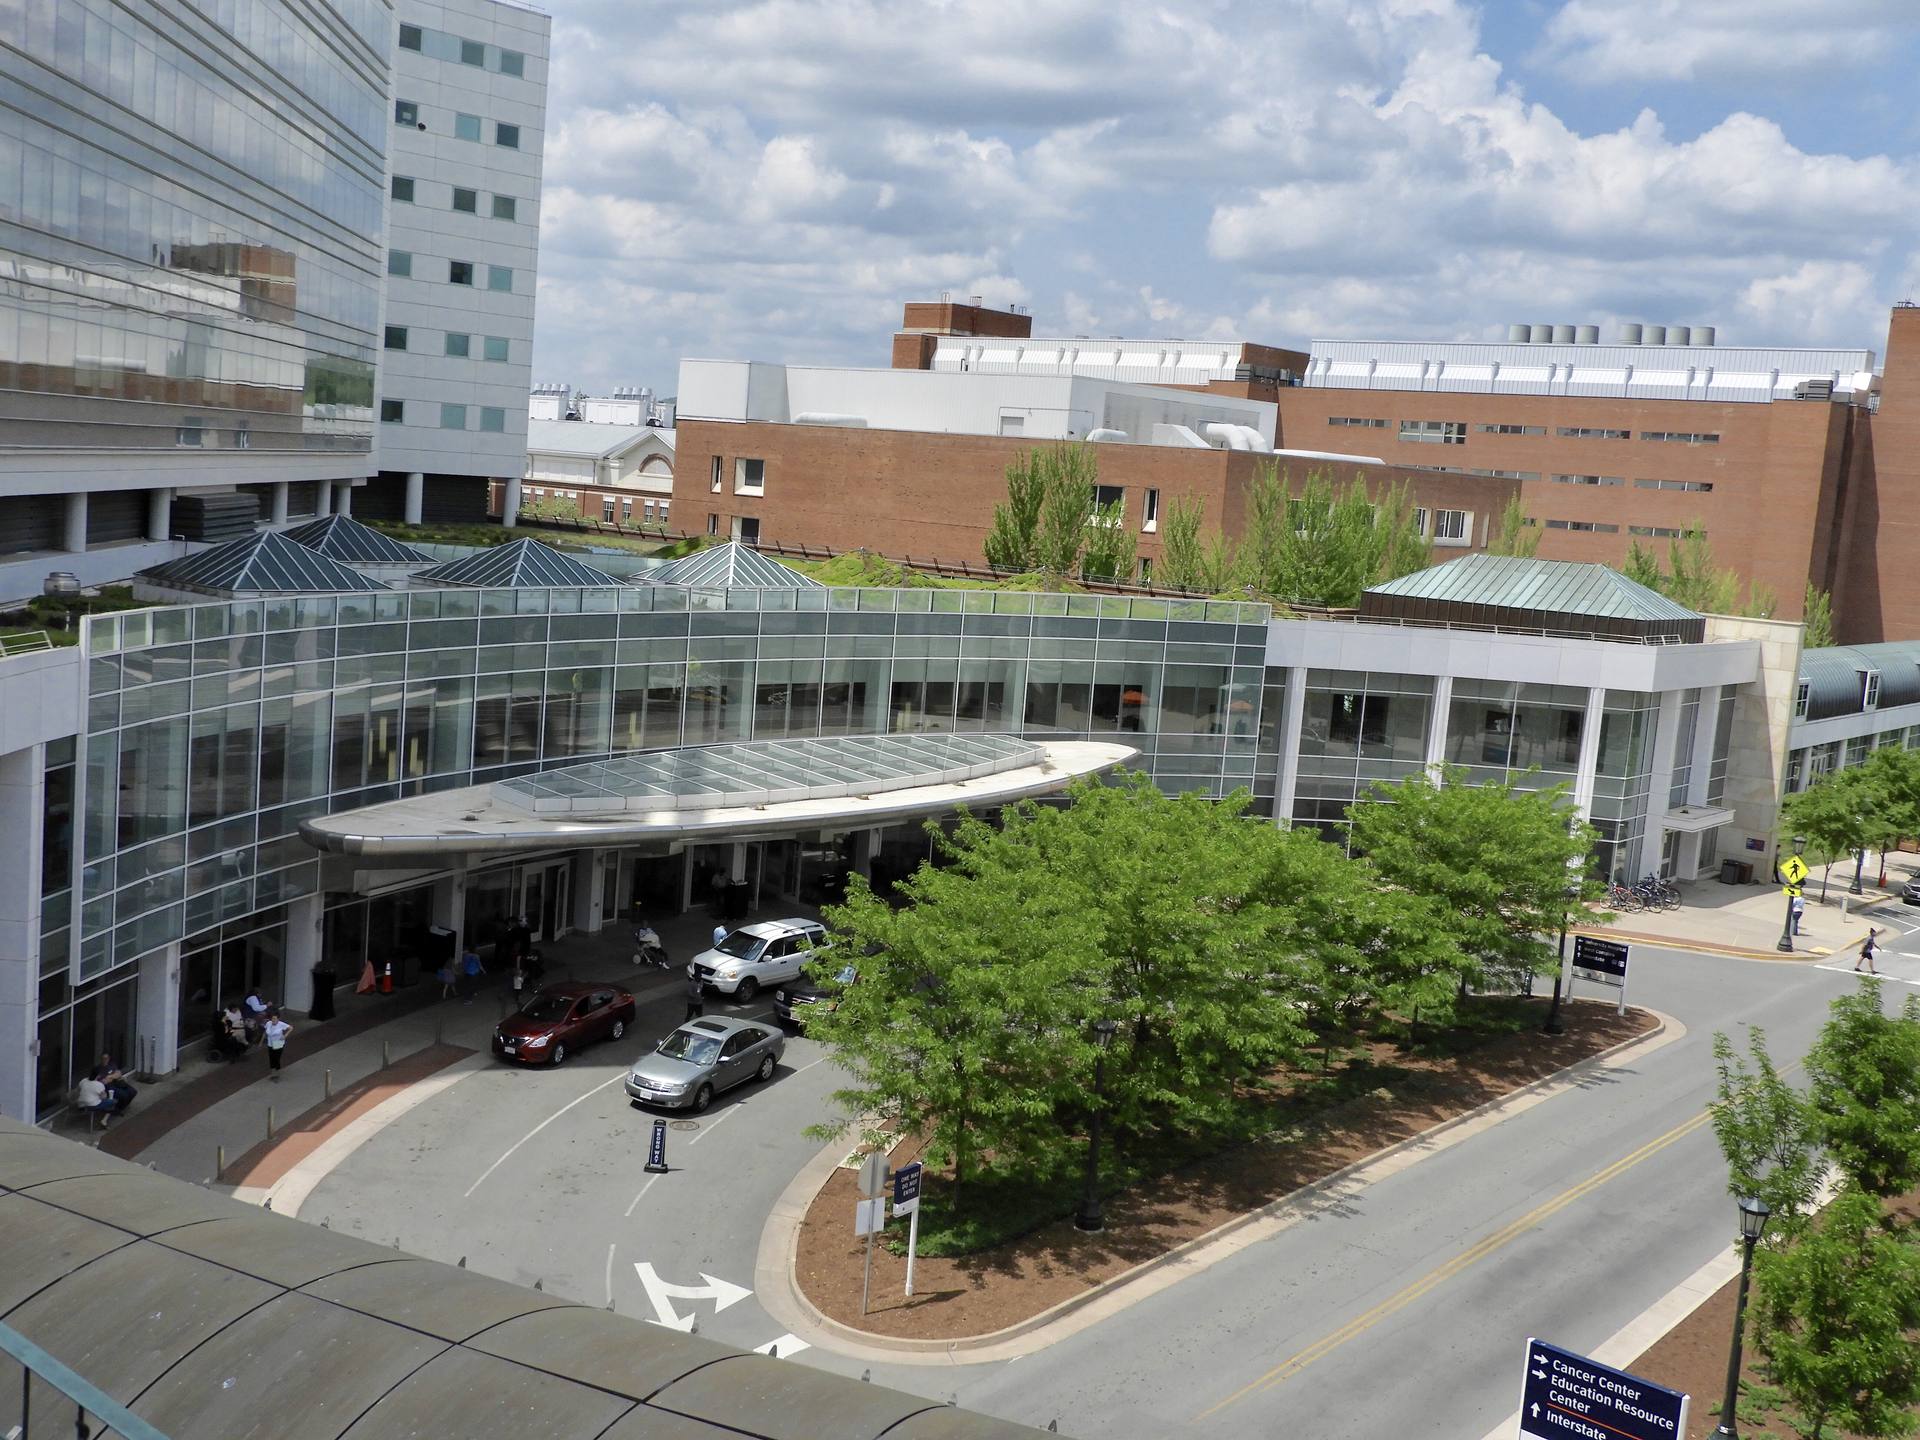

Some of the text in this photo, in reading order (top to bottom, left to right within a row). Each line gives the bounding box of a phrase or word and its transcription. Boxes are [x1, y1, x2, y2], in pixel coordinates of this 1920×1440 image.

[1553, 1360, 1641, 1400] Cancer Center
[1549, 1391, 1591, 1413] Center
[1551, 1375, 1674, 1430] Education Resource
[1546, 1410, 1607, 1440] Interstate
